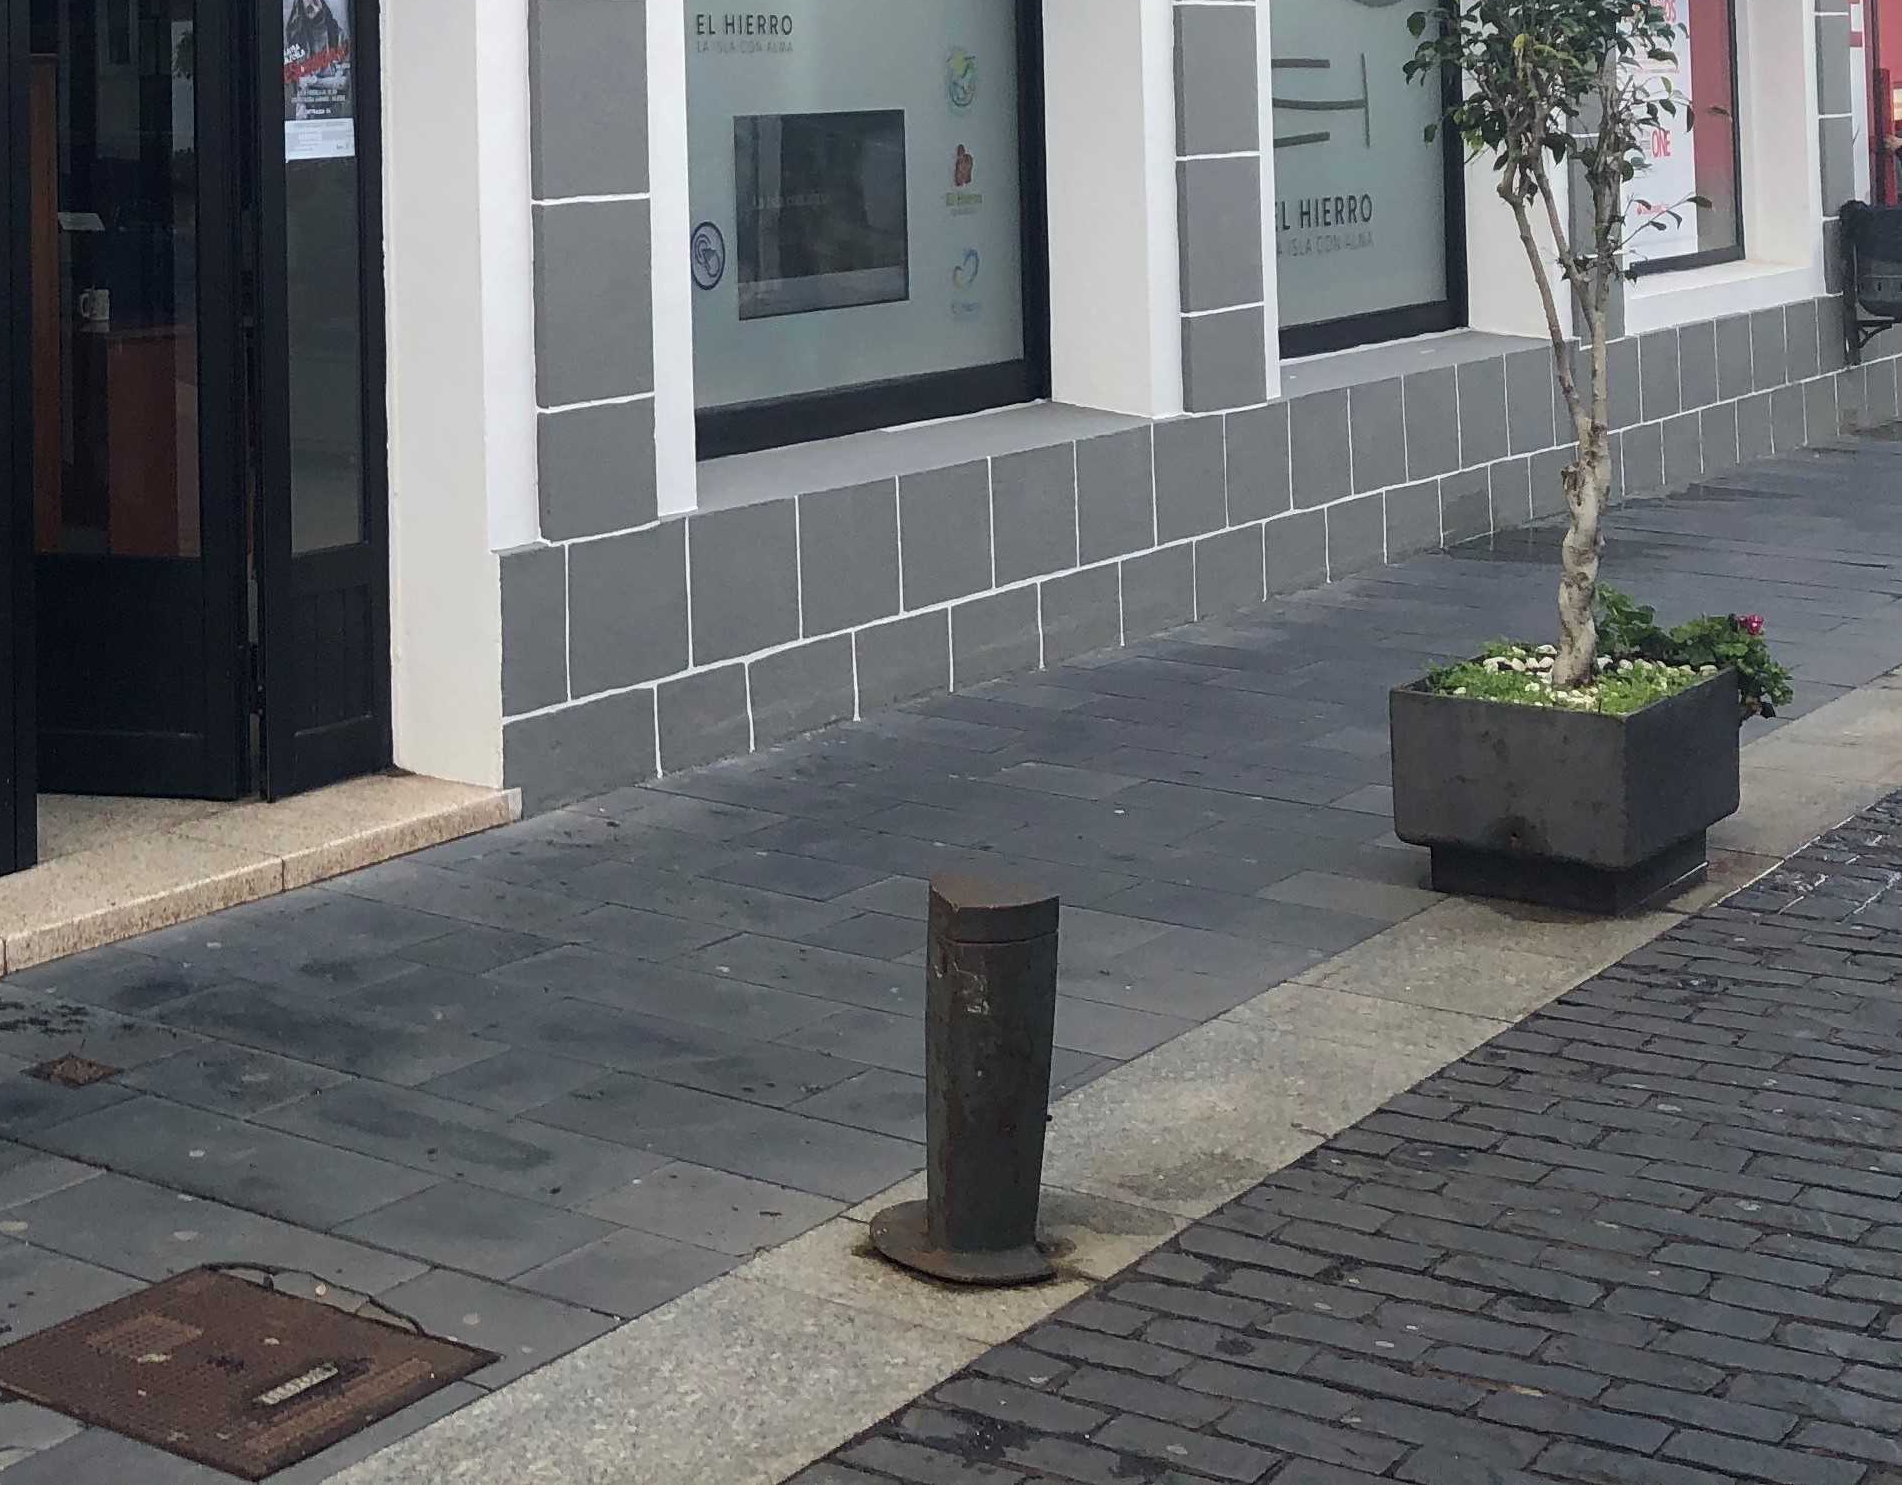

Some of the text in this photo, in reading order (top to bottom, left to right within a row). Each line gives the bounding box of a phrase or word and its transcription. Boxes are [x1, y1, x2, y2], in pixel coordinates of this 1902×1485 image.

[697, 14, 793, 35] EL HIERRO
[1651, 130, 1671, 157] ONE
[1300, 194, 1372, 229] HIERRO
